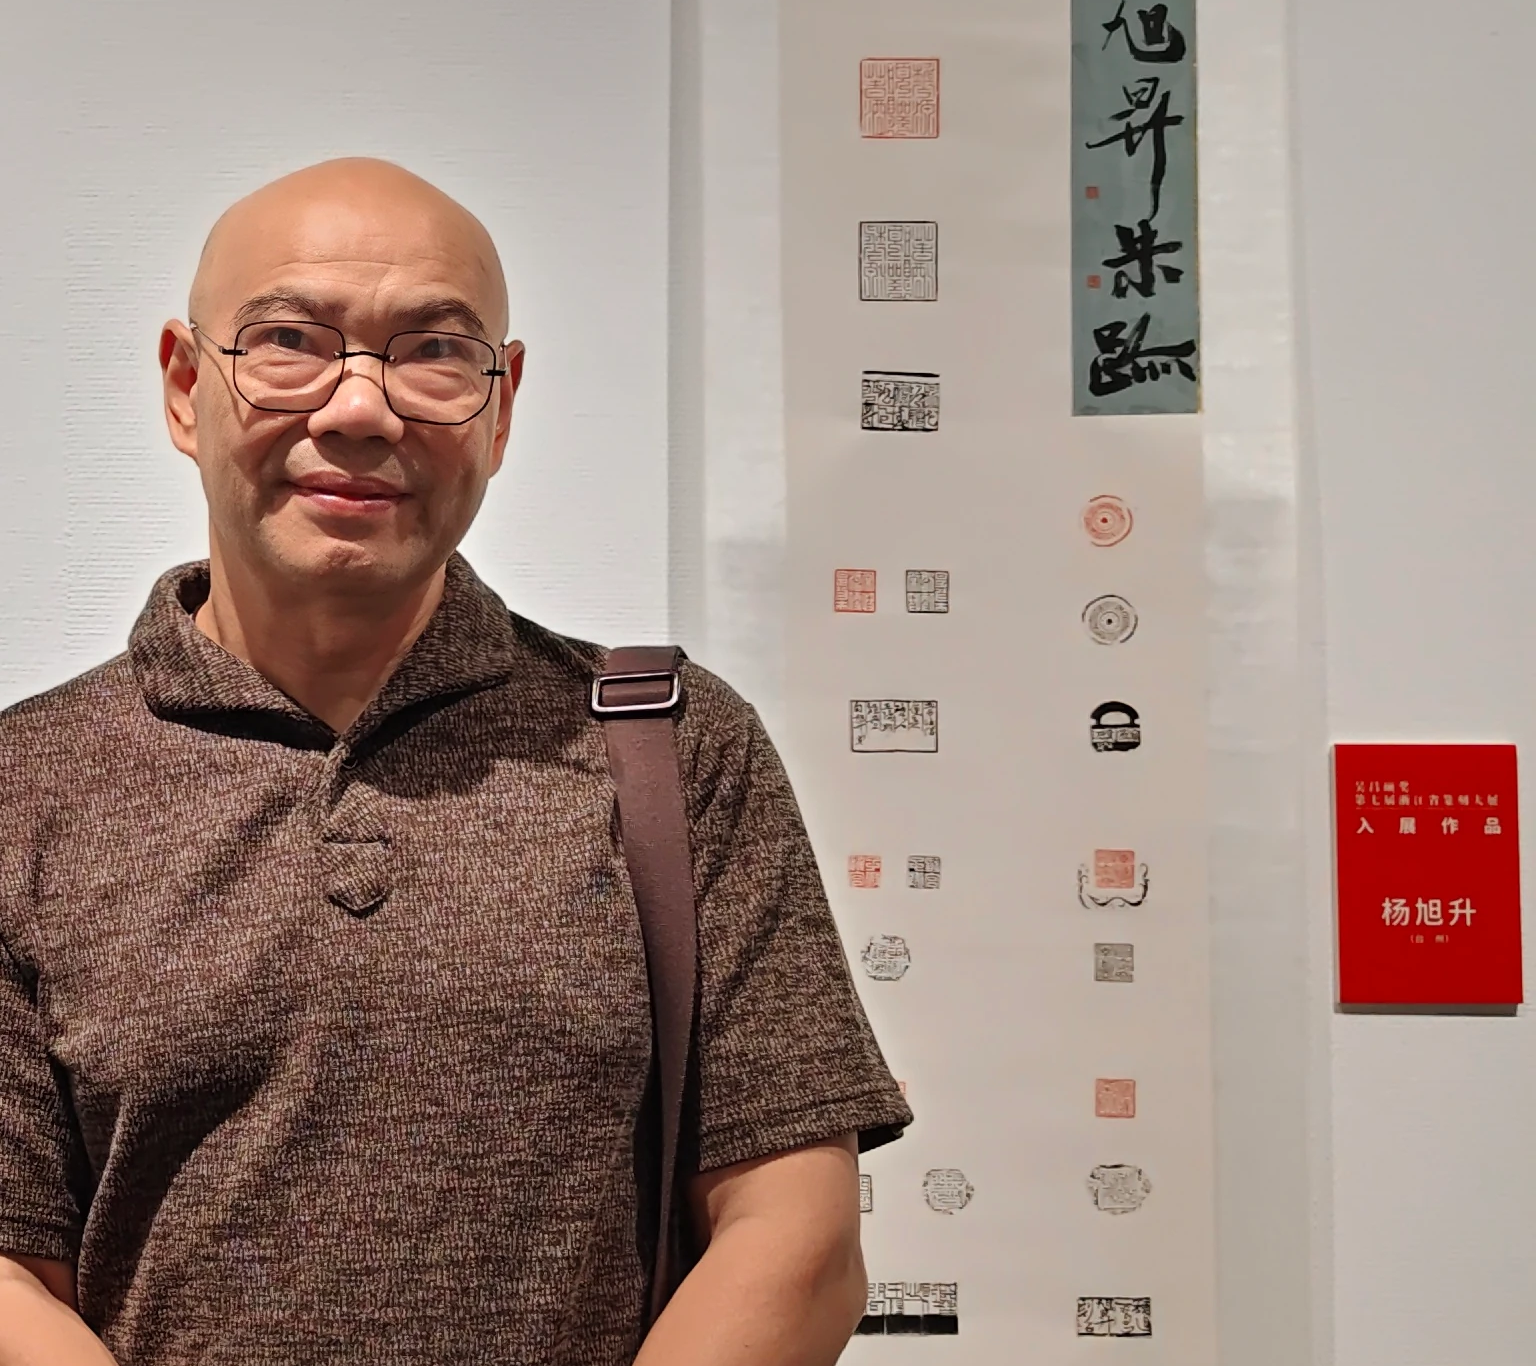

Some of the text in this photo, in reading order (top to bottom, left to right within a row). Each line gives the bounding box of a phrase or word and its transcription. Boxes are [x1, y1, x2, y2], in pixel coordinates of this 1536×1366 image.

[1356, 816, 1502, 835] 入展作品
[1381, 896, 1477, 927] 杨旭升
